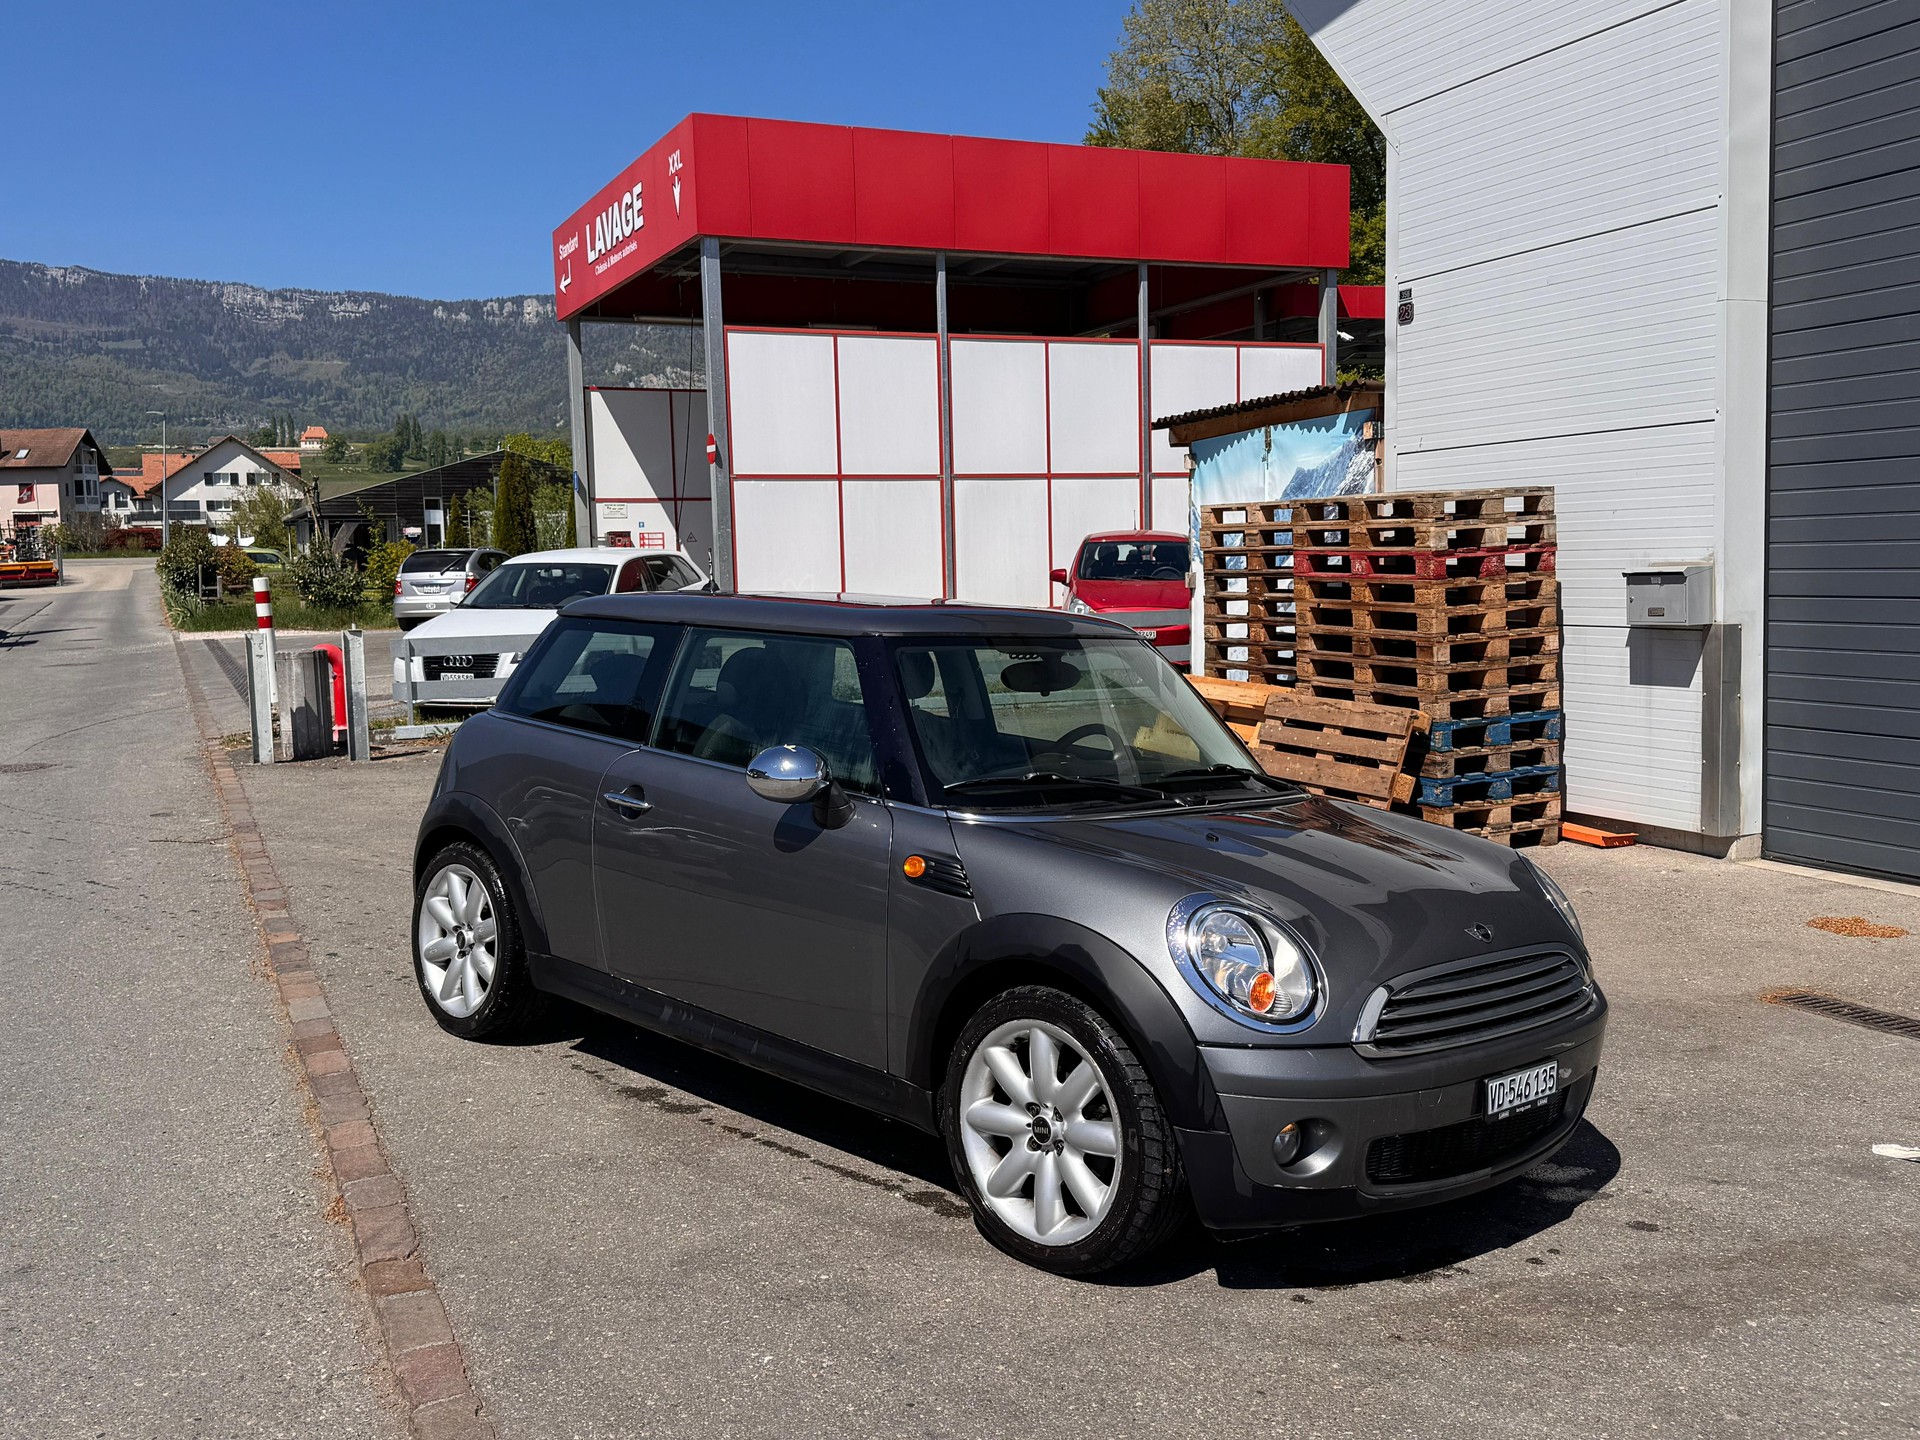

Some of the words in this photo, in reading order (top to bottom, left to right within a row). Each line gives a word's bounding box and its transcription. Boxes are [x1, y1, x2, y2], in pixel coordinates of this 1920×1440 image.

[668, 149, 683, 176] XXL
[585, 182, 645, 264] LAVAGE
[559, 231, 579, 260] Standard
[1399, 304, 1412, 321] 23
[1034, 1126, 1049, 1135] MINI
